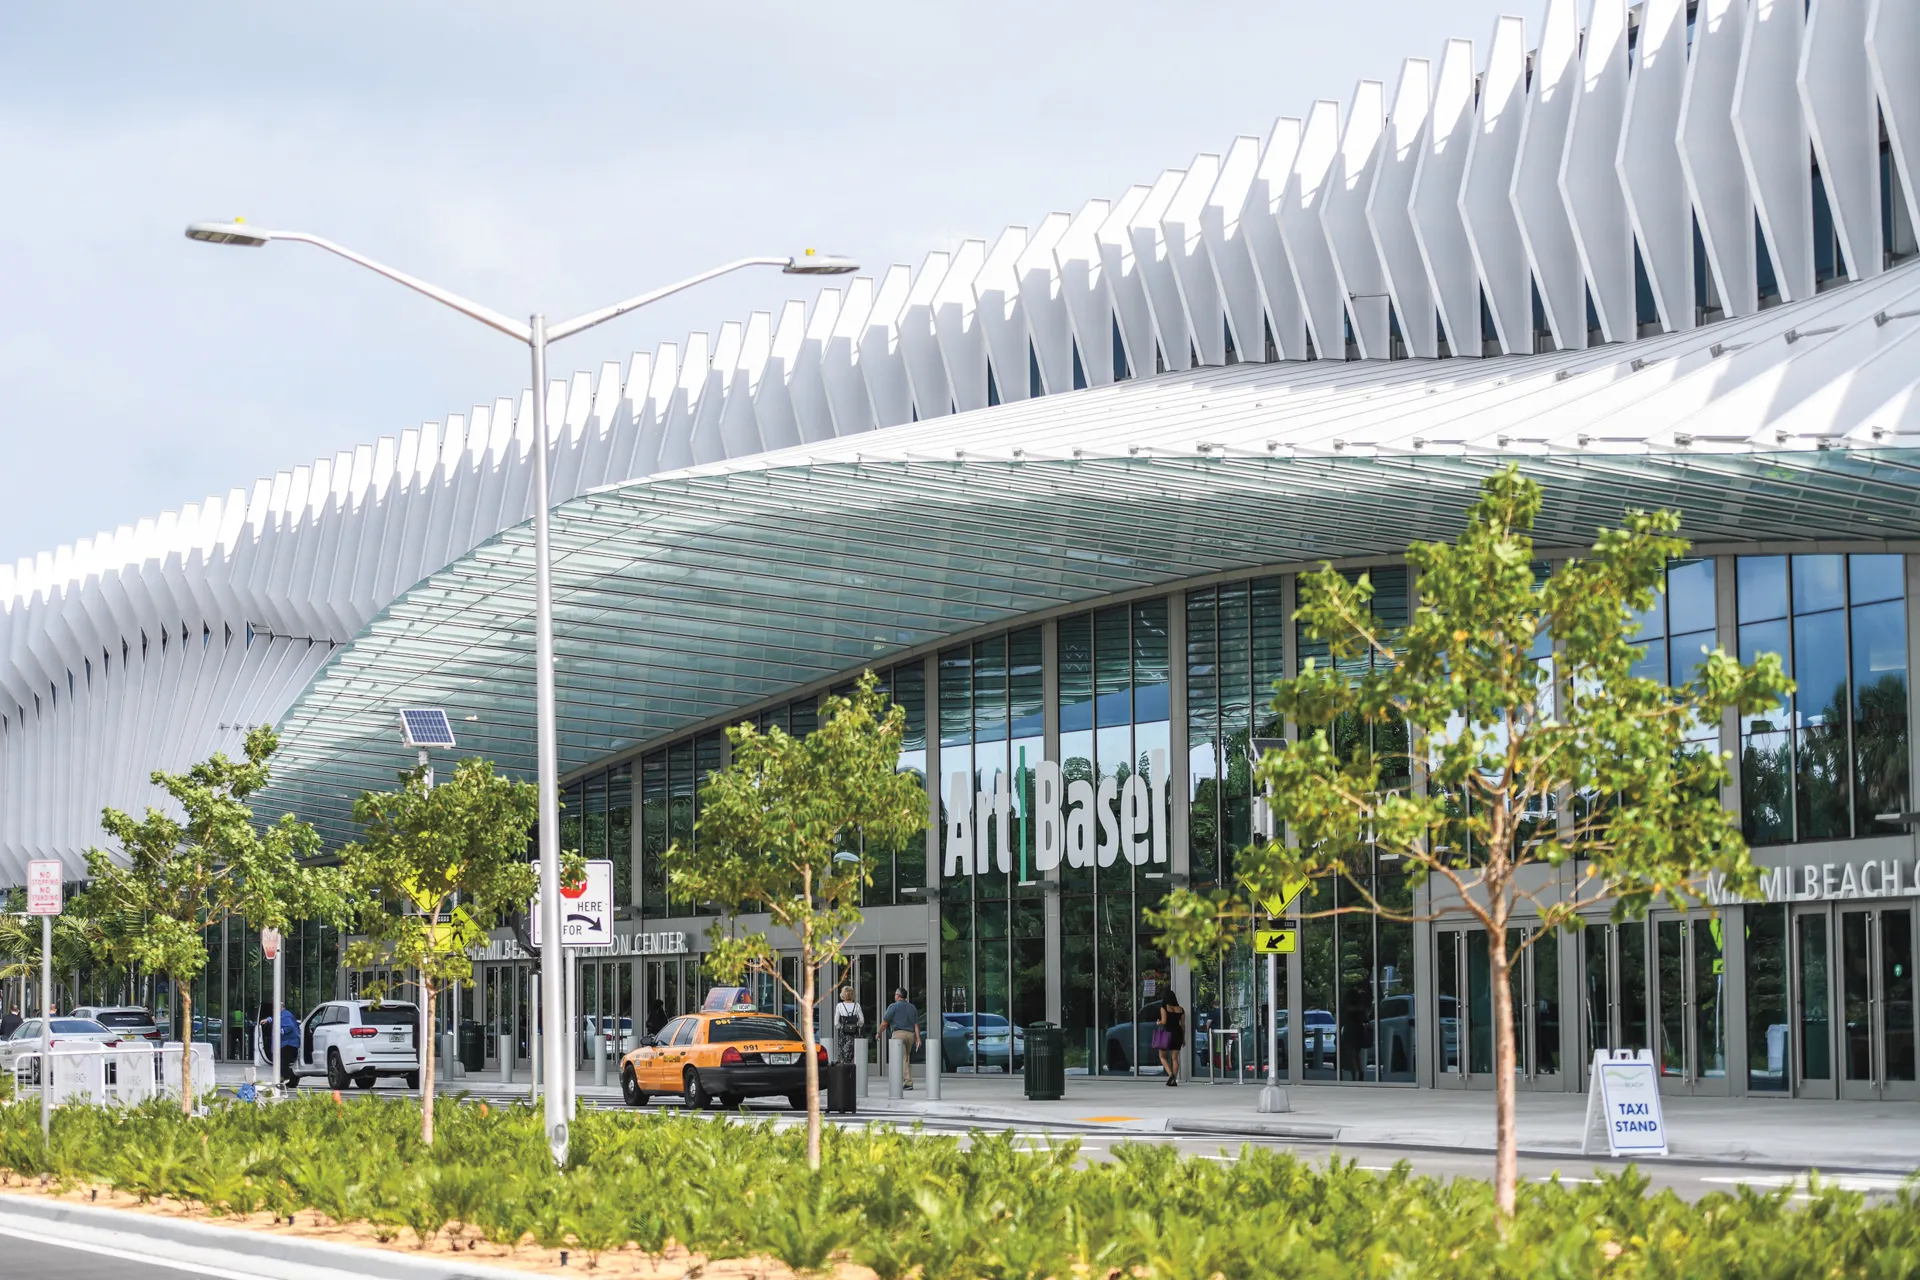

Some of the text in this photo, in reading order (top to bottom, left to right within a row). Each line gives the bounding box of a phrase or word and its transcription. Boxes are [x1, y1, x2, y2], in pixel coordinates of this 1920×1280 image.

[944, 748, 1167, 877] Art Basel
[39, 871, 51, 879] NO
[1706, 866, 1790, 904] MMI
[1804, 859, 1898, 900] BEACH
[39, 886, 51, 894] NO
[577, 901, 603, 912] HERE
[562, 925, 582, 936] FOR
[634, 931, 686, 955] CENTER
[1618, 1103, 1649, 1115] TAXI
[1615, 1121, 1657, 1132] STAND
